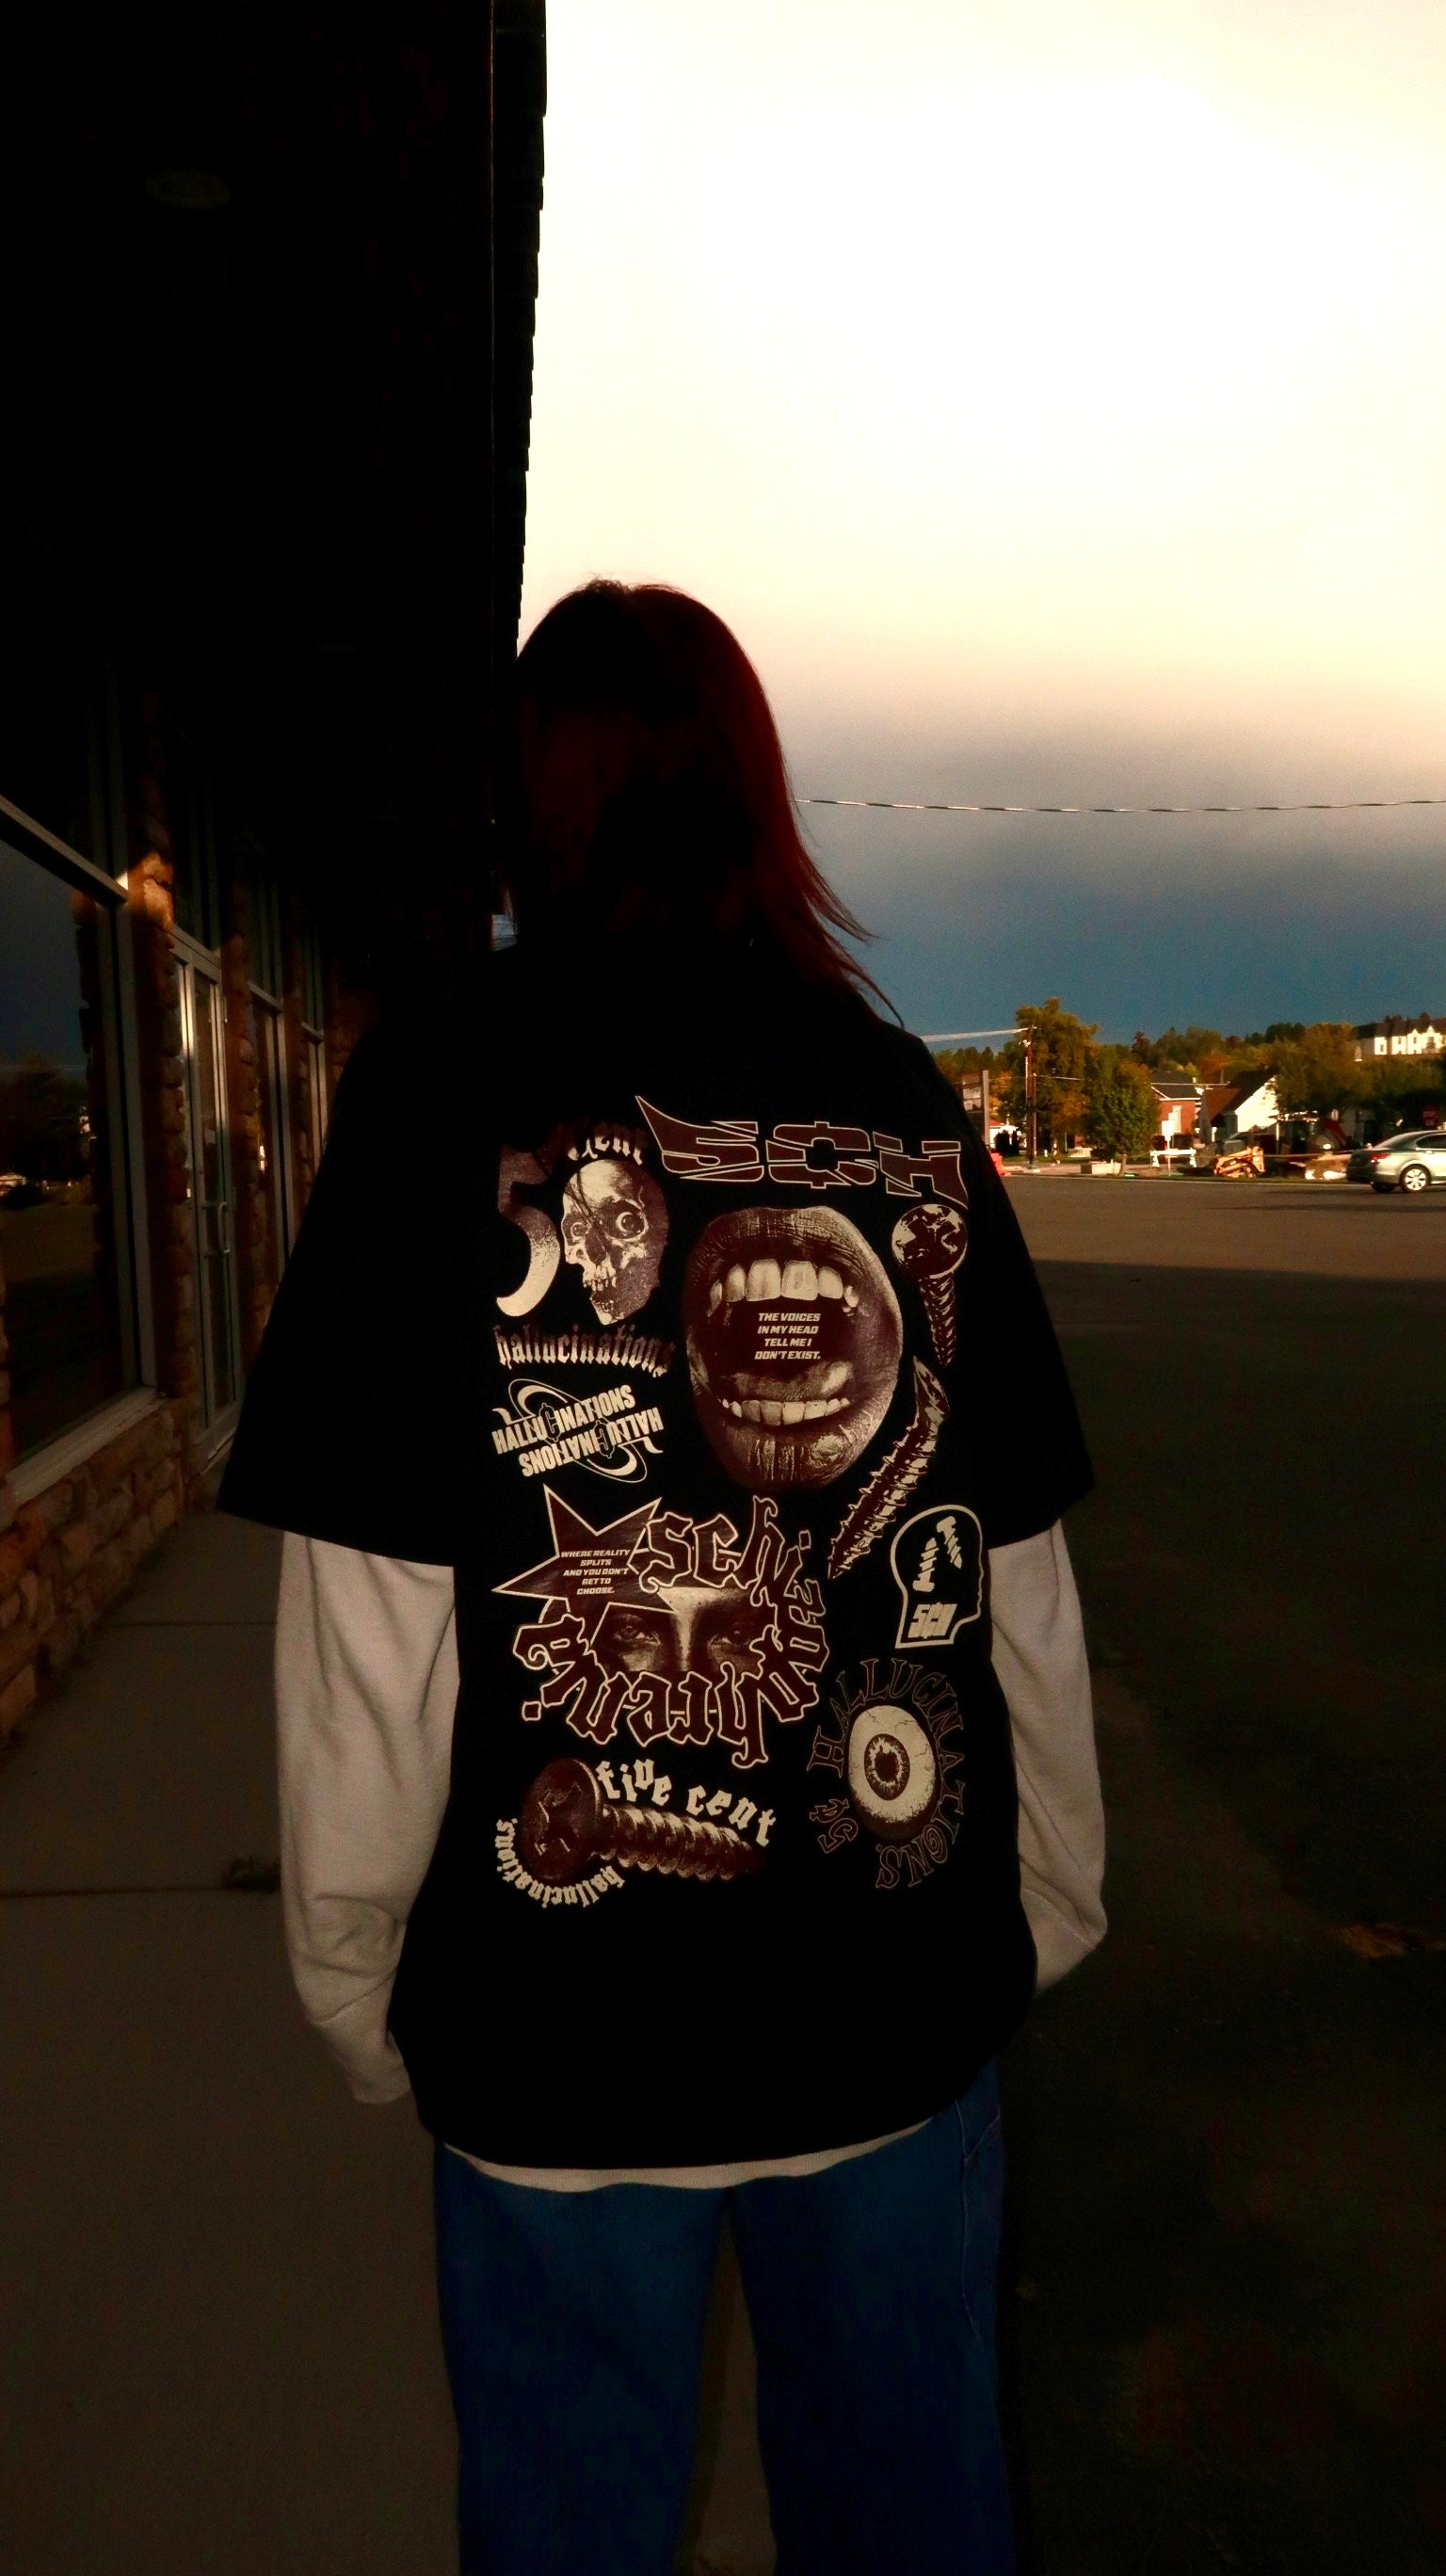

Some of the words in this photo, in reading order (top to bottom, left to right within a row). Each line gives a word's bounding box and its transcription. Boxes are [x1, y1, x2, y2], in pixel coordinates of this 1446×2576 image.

[758, 1312, 779, 1322] THE
[780, 1312, 821, 1322] VOICES
[757, 1326, 770, 1334] IN
[770, 1326, 789, 1334] MY
[788, 1326, 819, 1334] HEAD
[764, 1338, 789, 1347] TELL
[790, 1338, 807, 1347] ME
[807, 1338, 812, 1347] I
[754, 1350, 787, 1360] DON'T
[787, 1350, 821, 1360] EXIST.
[560, 1550, 593, 1558] WHERE
[593, 1549, 631, 1557] REALITY
[580, 1558, 612, 1567] SPLITS
[563, 1569, 583, 1577] AND
[602, 1568, 629, 1576] DON'T
[576, 1586, 615, 1595] CHOOSE.
[595, 1758, 673, 1808] five
[685, 1785, 777, 1847] cent
